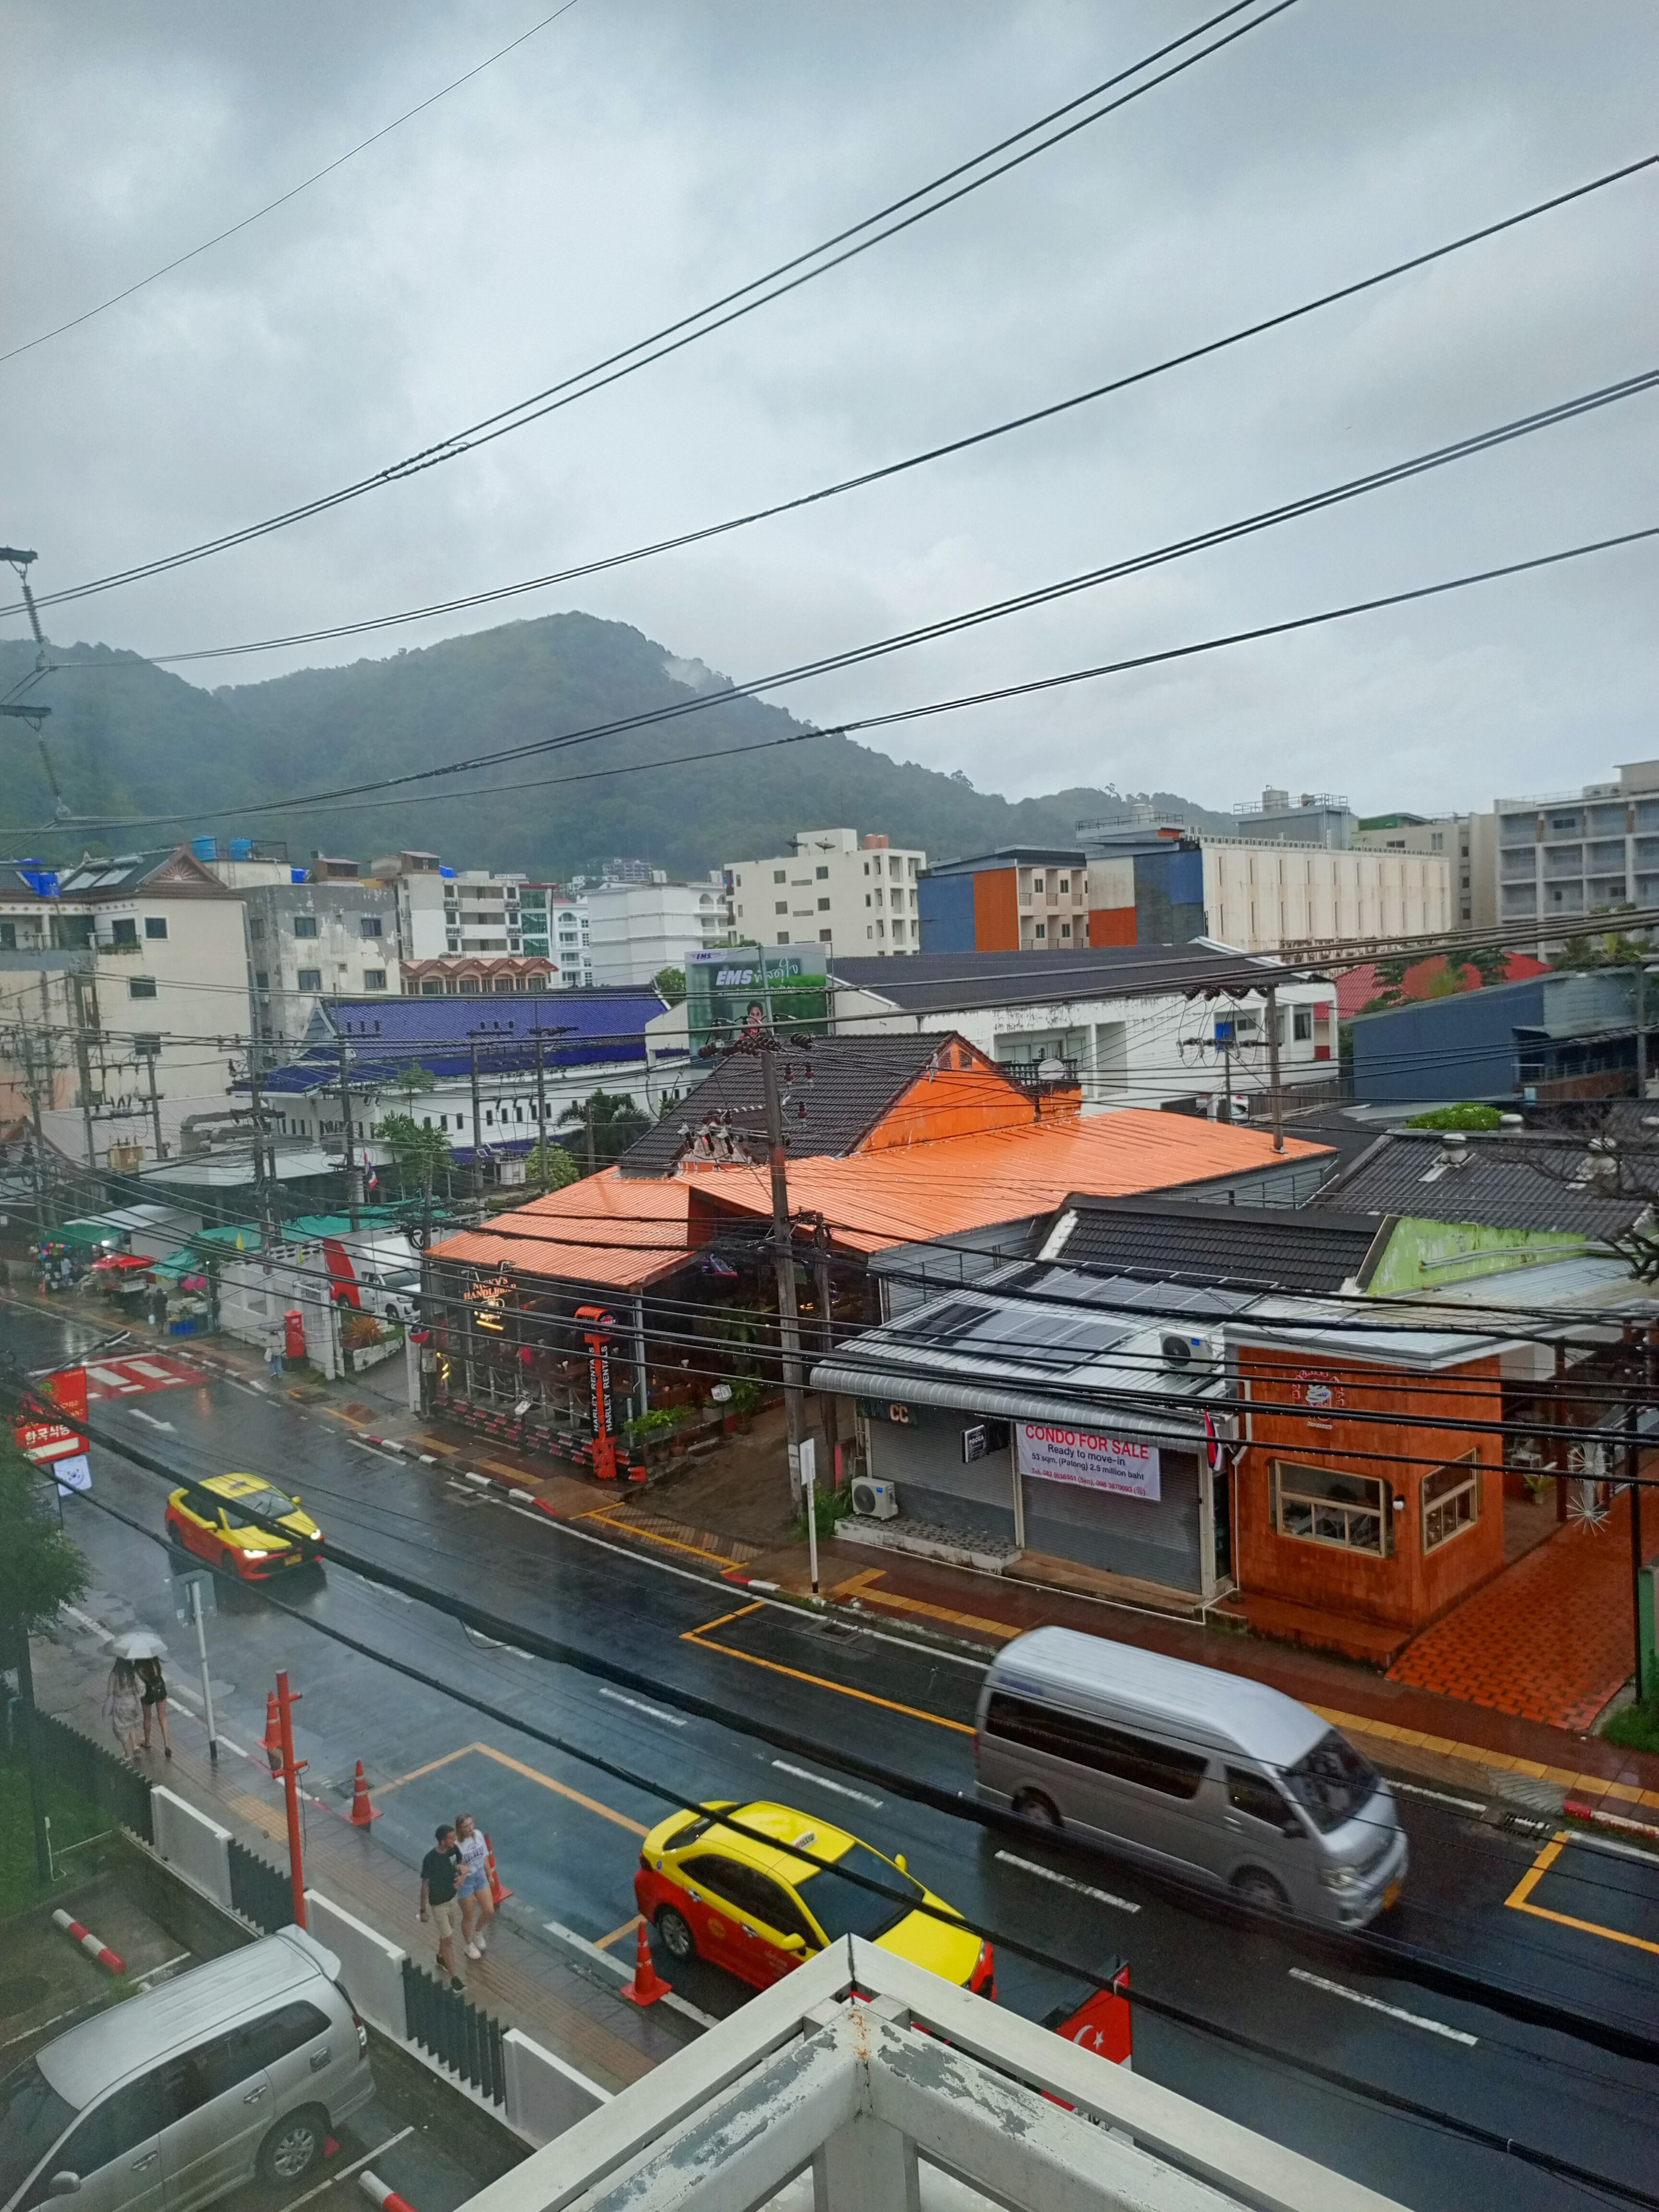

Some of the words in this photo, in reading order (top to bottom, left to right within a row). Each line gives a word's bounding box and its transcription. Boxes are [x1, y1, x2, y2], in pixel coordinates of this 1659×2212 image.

[715, 969, 753, 986] EMS
[604, 1394, 613, 1431] HARLEY
[1025, 1424, 1075, 1446] CONDO
[1079, 1433, 1108, 1452] FOR
[1112, 1440, 1149, 1460] SALE
[1047, 1443, 1074, 1458] Ready
[1077, 1449, 1085, 1458] to
[1088, 1452, 1126, 1466] move-in
[1041, 1455, 1058, 1464] sqm.
[1058, 1458, 1088, 1471] (Patong)
[1090, 1463, 1101, 1472] 2.5
[1102, 1467, 1126, 1477] million
[1128, 1471, 1144, 1480] baht
